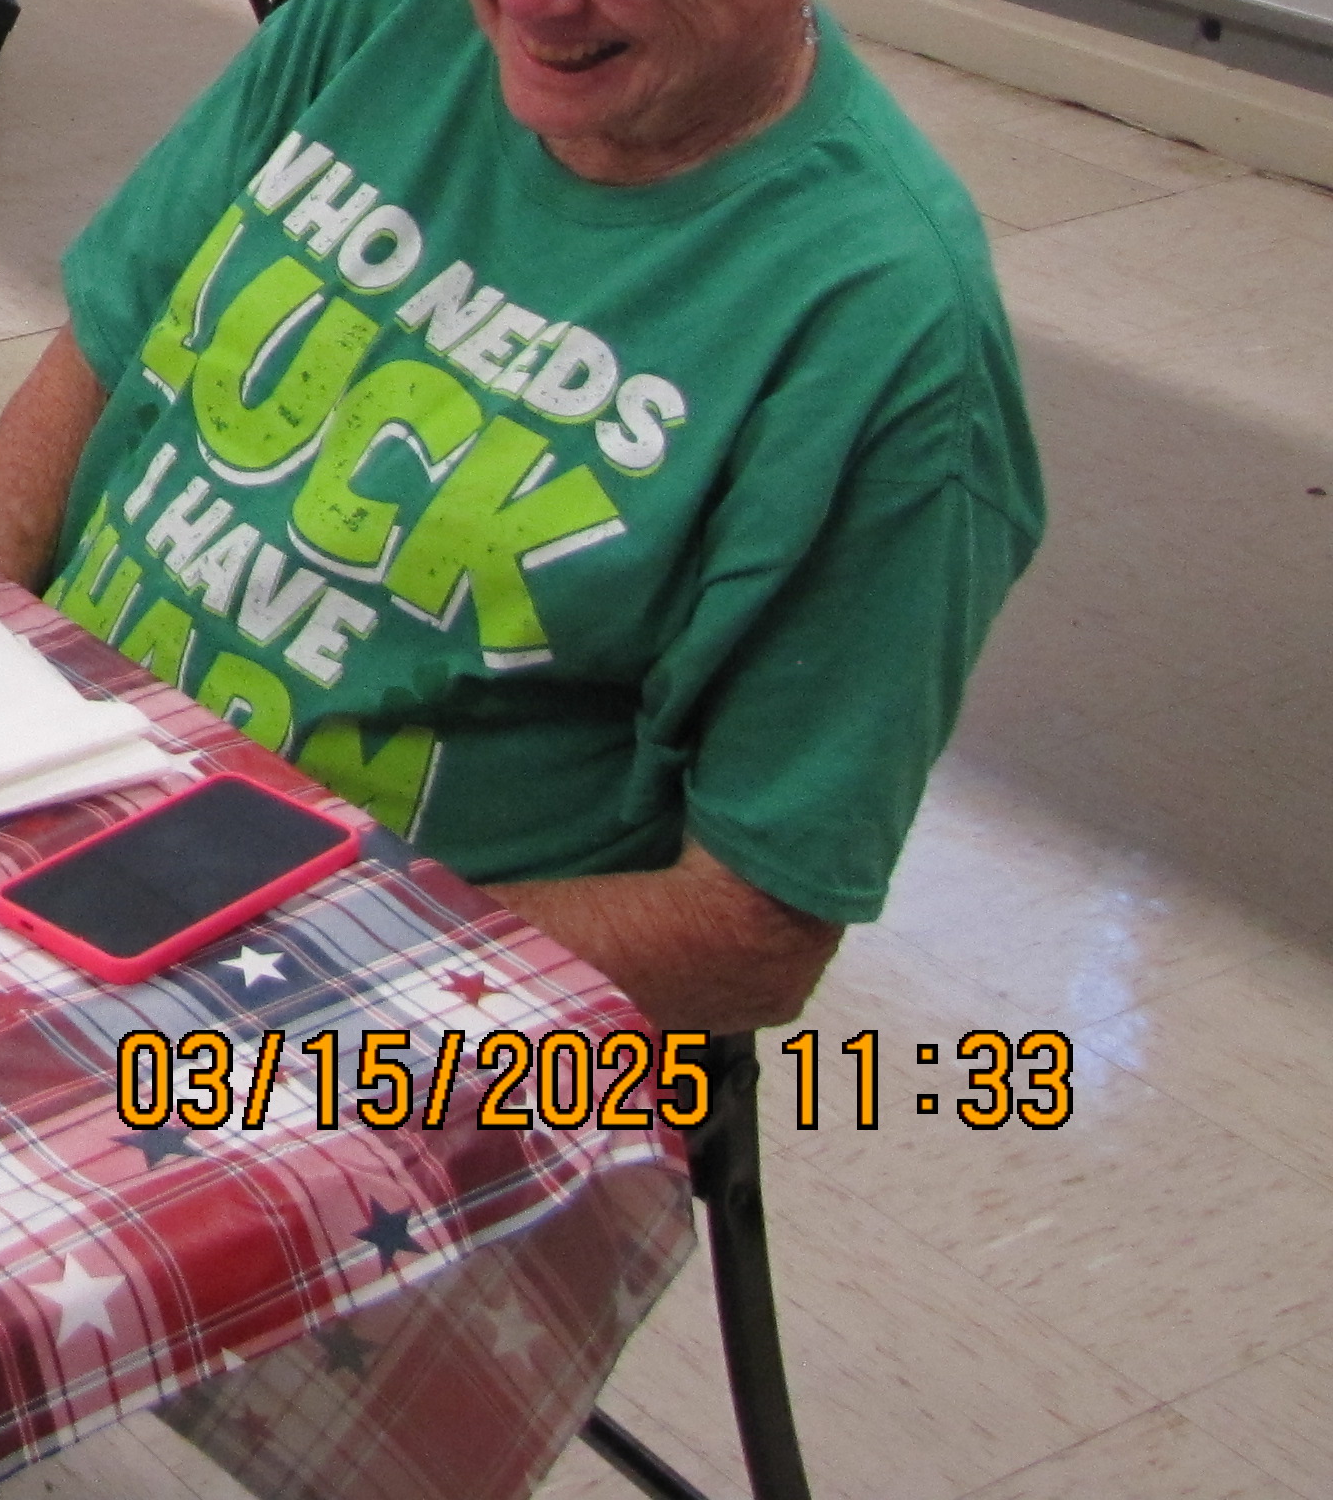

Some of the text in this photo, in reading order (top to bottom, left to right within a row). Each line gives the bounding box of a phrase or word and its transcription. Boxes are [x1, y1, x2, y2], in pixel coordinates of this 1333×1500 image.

[140, 202, 627, 669] LUCK
[395, 259, 687, 477] NEEDS
[123, 442, 379, 690] I HAVE
